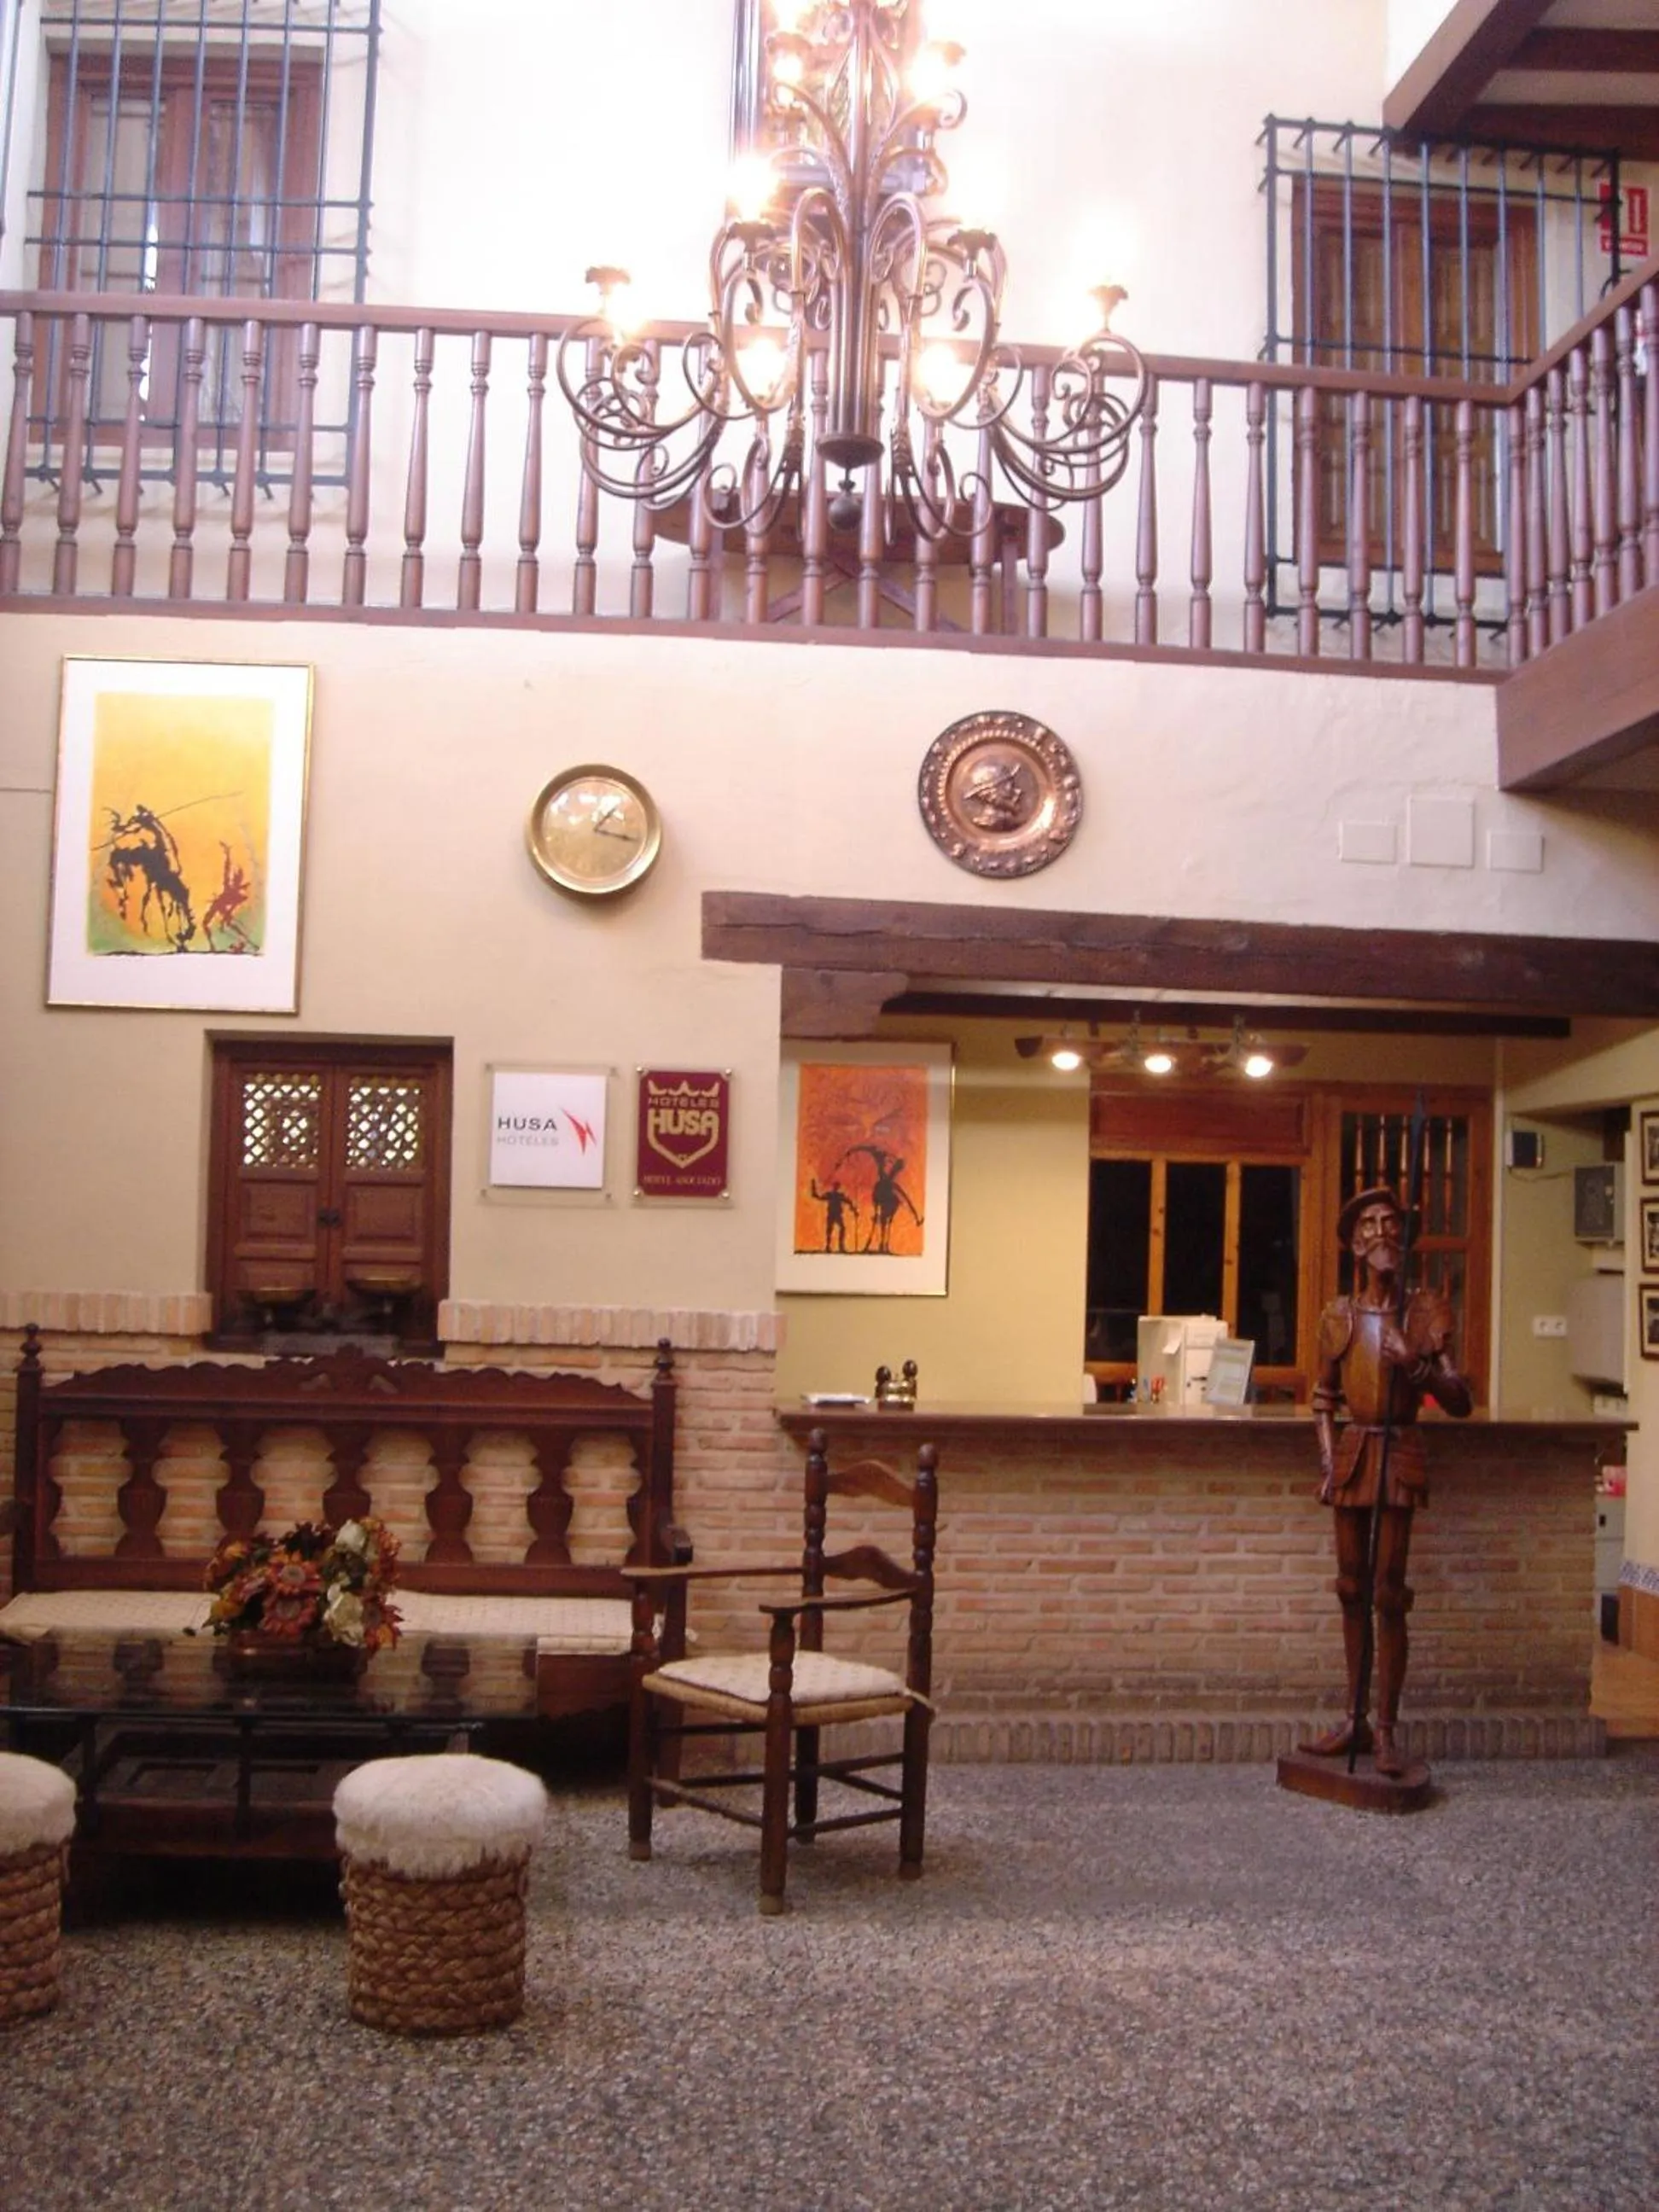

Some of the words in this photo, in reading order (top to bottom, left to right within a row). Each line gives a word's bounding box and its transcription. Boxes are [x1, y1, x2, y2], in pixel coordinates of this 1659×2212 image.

[648, 1097, 719, 1109] HOTELES
[498, 1116, 557, 1132] HUSA
[648, 1109, 719, 1136] HUSA
[497, 1136, 559, 1147] HOTELES
